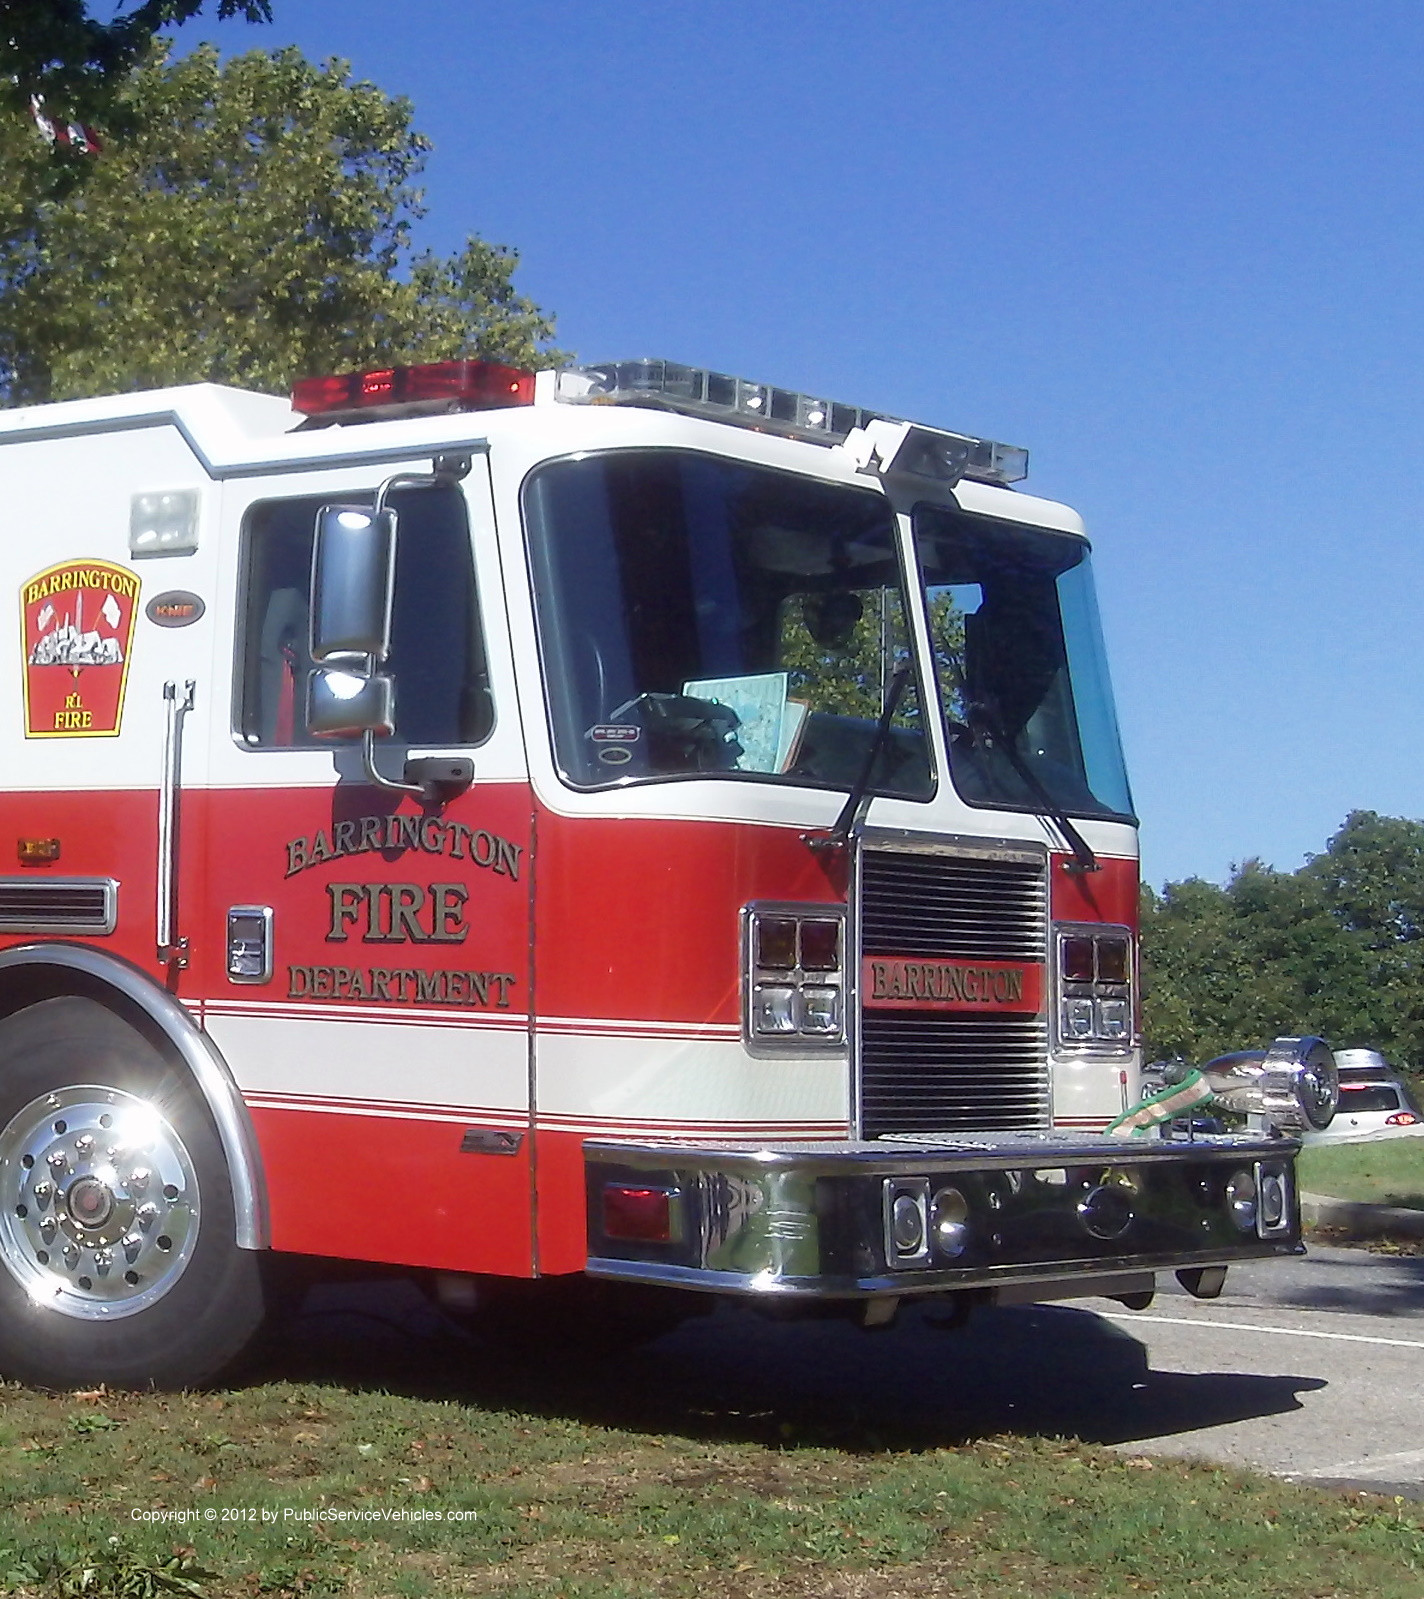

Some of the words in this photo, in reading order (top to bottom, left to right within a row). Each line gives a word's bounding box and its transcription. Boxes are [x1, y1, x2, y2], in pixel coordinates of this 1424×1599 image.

[27, 569, 134, 605] BARRINGTON
[54, 711, 93, 729] FIRE
[284, 814, 523, 881] BARRINGTON
[325, 882, 469, 945] FIRE
[287, 965, 516, 1007] DEPARTMENT
[871, 962, 1023, 1002] BARRINGTON
